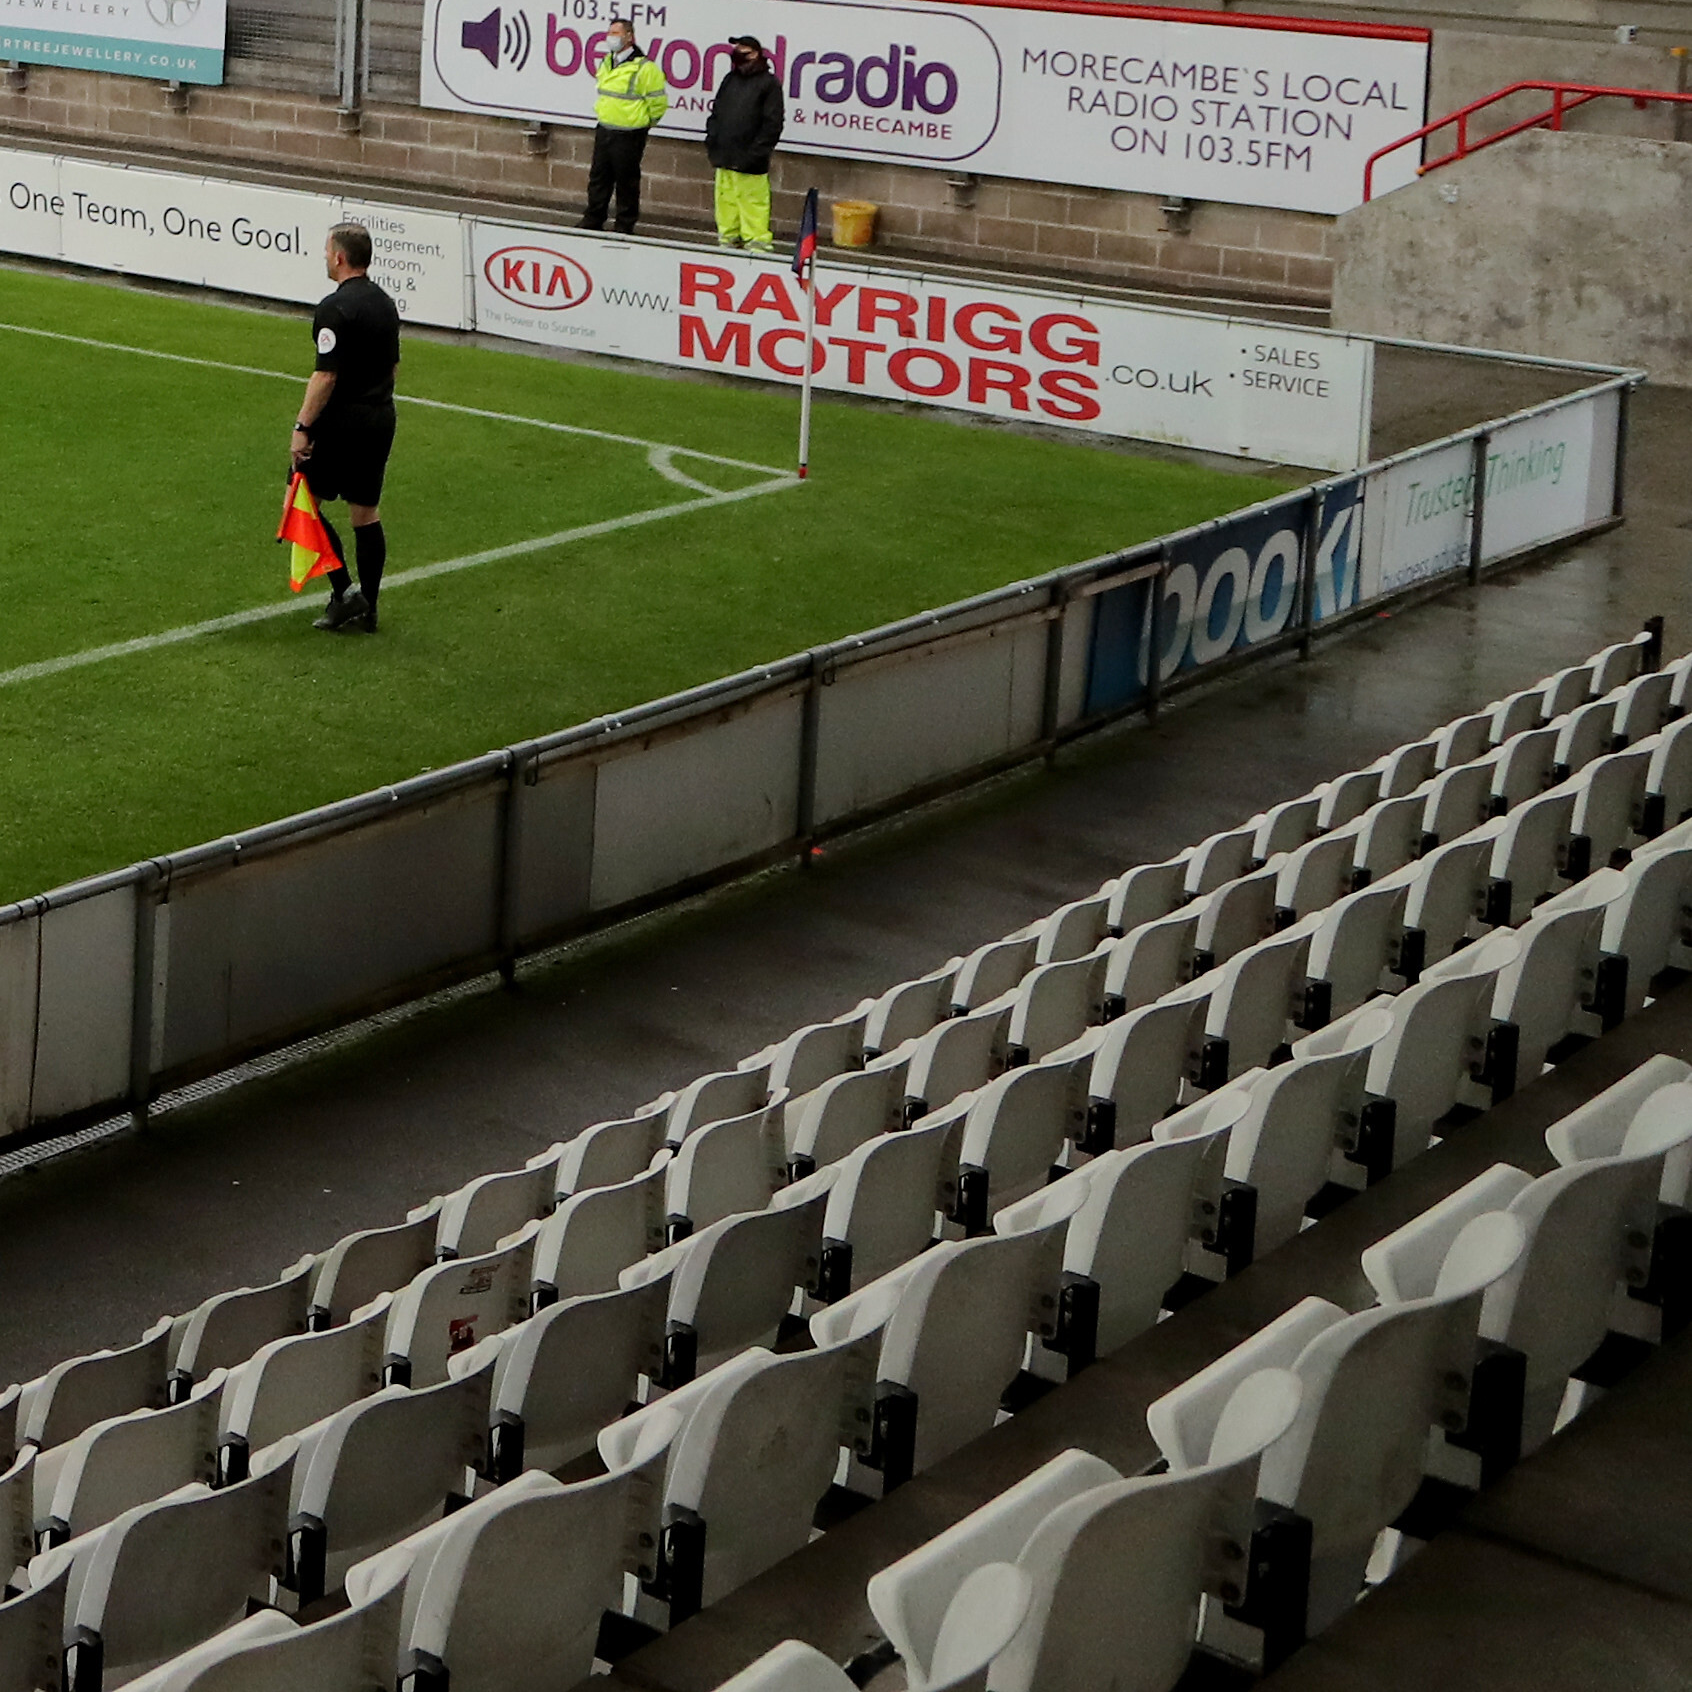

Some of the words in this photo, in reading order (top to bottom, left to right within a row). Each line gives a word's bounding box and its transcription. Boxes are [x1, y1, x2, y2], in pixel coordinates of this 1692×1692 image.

[632, 2, 667, 27] FM
[1283, 72, 1408, 110] LOCAL
[793, 108, 806, 124] &
[814, 110, 952, 140] MORECAMBE
[1069, 87, 1178, 122] RADIO
[1191, 100, 1352, 141] STATION
[1111, 126, 1167, 155] ON
[1186, 133, 1312, 172] 103.5FM
[9, 182, 65, 216] One
[72, 191, 155, 237] Team,
[163, 207, 222, 242] One
[231, 216, 310, 256] Goal.
[373, 236, 445, 259] agement,
[406, 277, 417, 291] &
[502, 257, 573, 299] KIA
[484, 308, 502, 322] The
[504, 313, 534, 328] Power
[538, 319, 549, 331] to
[551, 320, 597, 338] Surprise
[678, 262, 1100, 367] RAYRIGG
[678, 315, 1101, 421] MOTORS
[1254, 344, 1320, 371] SALES
[1105, 364, 1214, 398] .co.uk
[1242, 368, 1330, 399] SERVICE
